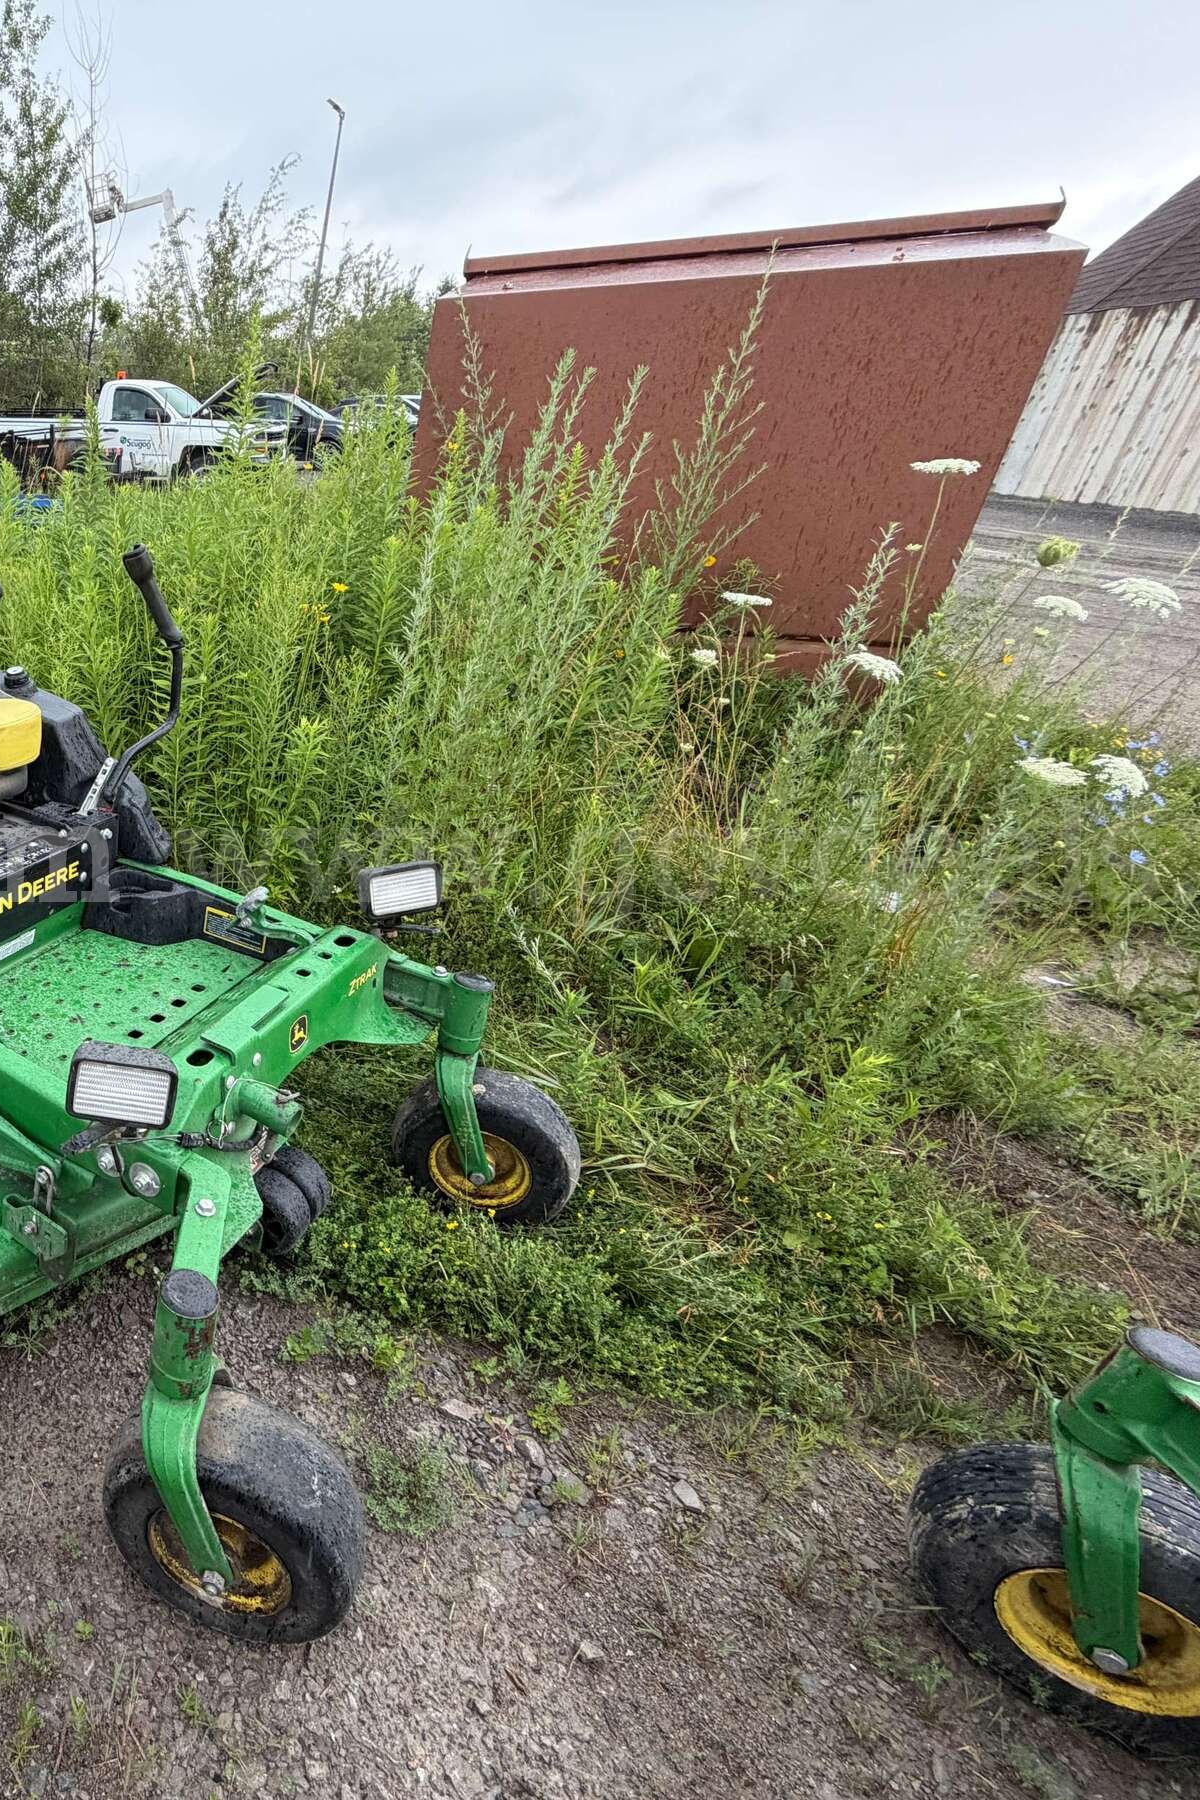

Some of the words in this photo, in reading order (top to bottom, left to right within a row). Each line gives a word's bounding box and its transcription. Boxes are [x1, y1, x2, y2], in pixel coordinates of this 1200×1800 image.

[126, 438, 152, 450] Scugog
[17, 860, 81, 905] DEERE
[347, 961, 379, 997] ZTRAK
